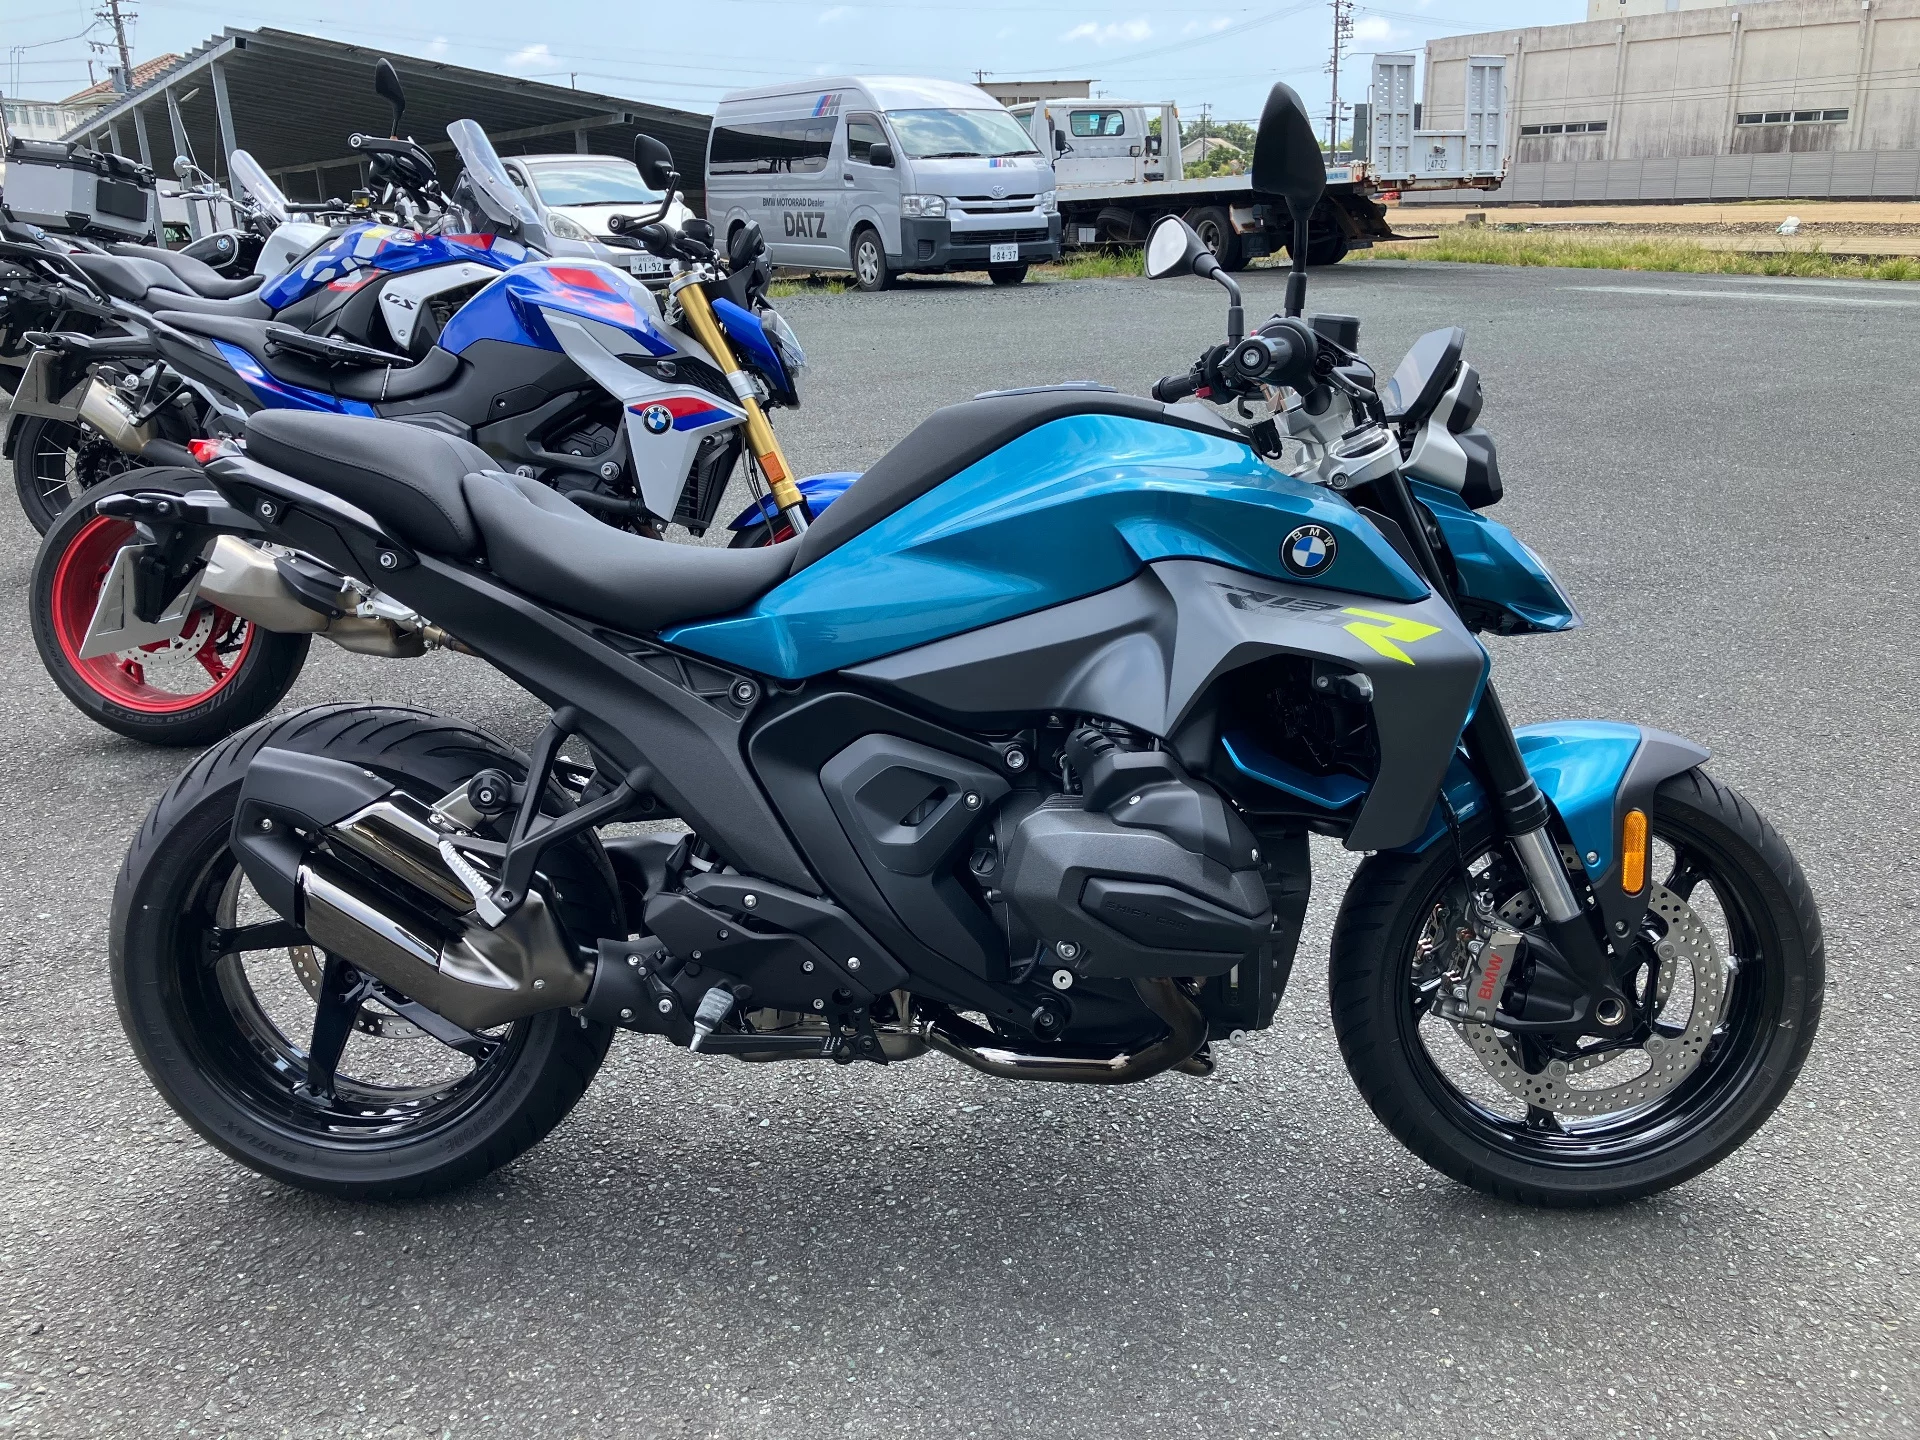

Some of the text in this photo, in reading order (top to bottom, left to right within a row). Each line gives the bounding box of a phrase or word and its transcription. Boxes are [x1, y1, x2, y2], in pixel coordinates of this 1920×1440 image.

[762, 197, 825, 208] BMW MOTORRAD Dealer
[783, 211, 828, 239] DATZ
[996, 250, 1017, 261] 84-37
[638, 261, 662, 272] 41-92
[383, 292, 419, 311] GS
[1291, 527, 1335, 547] BMW
[1477, 952, 1504, 1000] BMW
